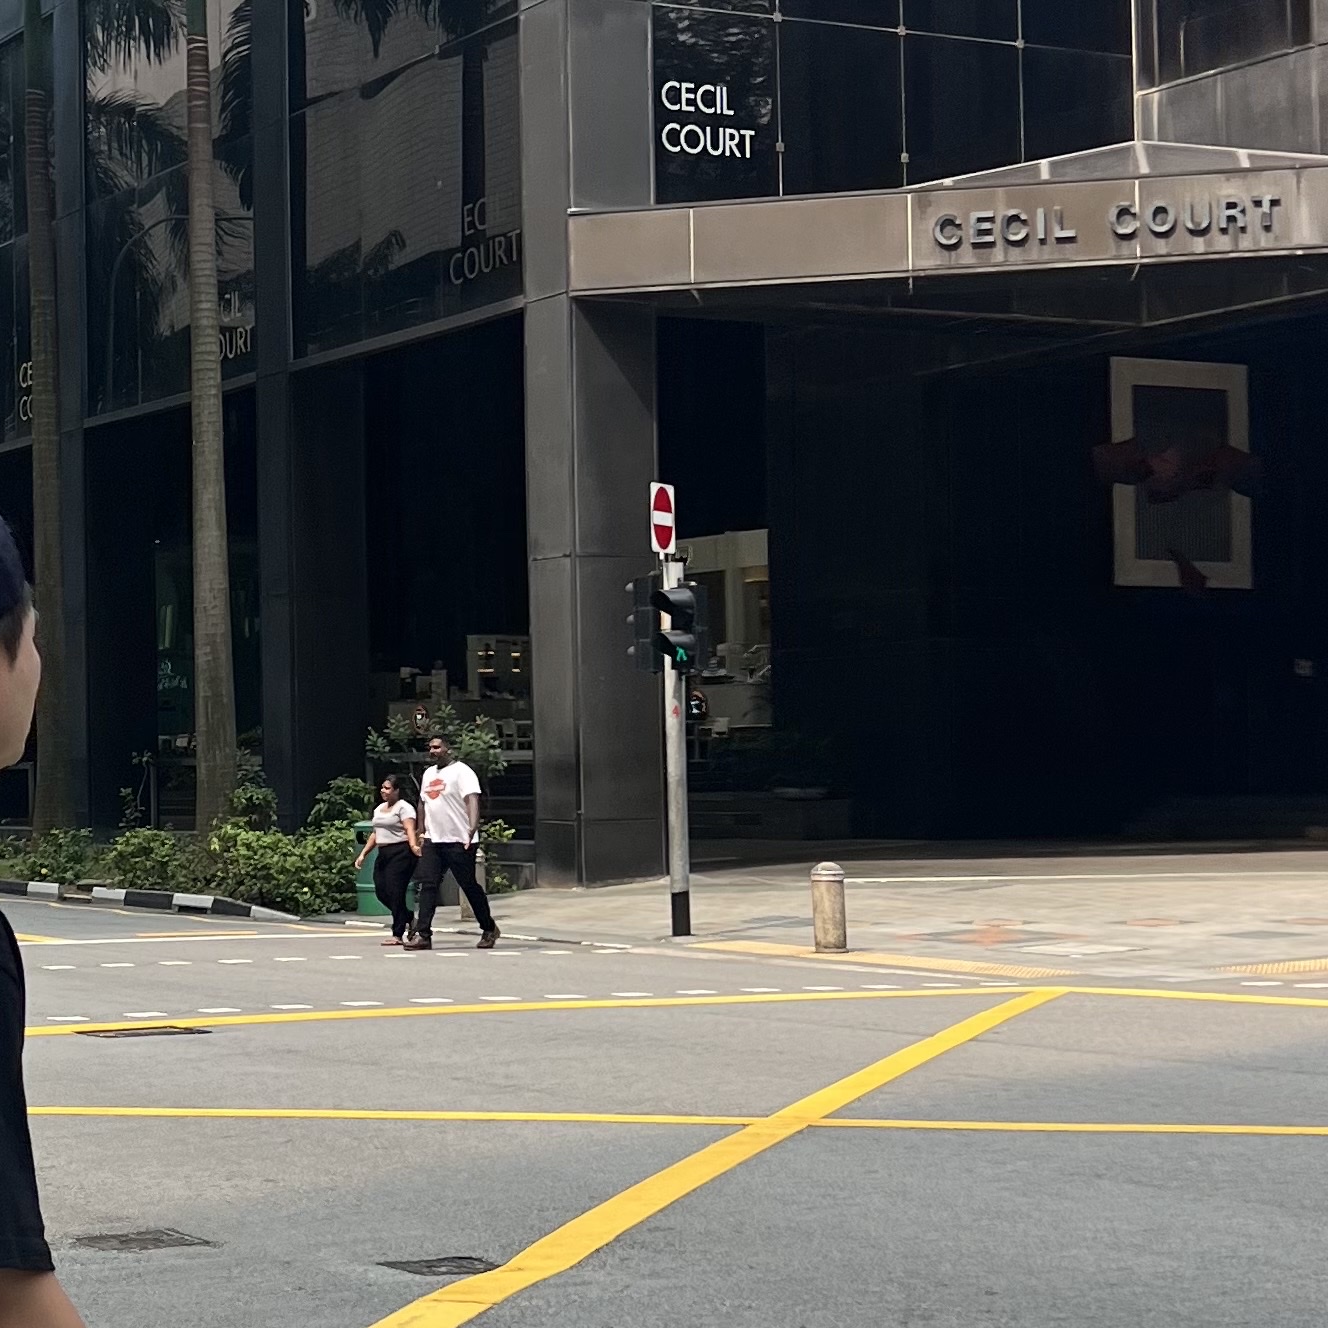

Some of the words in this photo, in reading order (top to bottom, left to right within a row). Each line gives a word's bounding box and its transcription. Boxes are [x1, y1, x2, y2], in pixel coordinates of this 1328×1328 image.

[661, 80, 735, 116] CECIL
[661, 122, 756, 159] COURT
[933, 205, 1077, 249] CECIL
[1108, 194, 1282, 239] COURT
[449, 228, 521, 285] COURT
